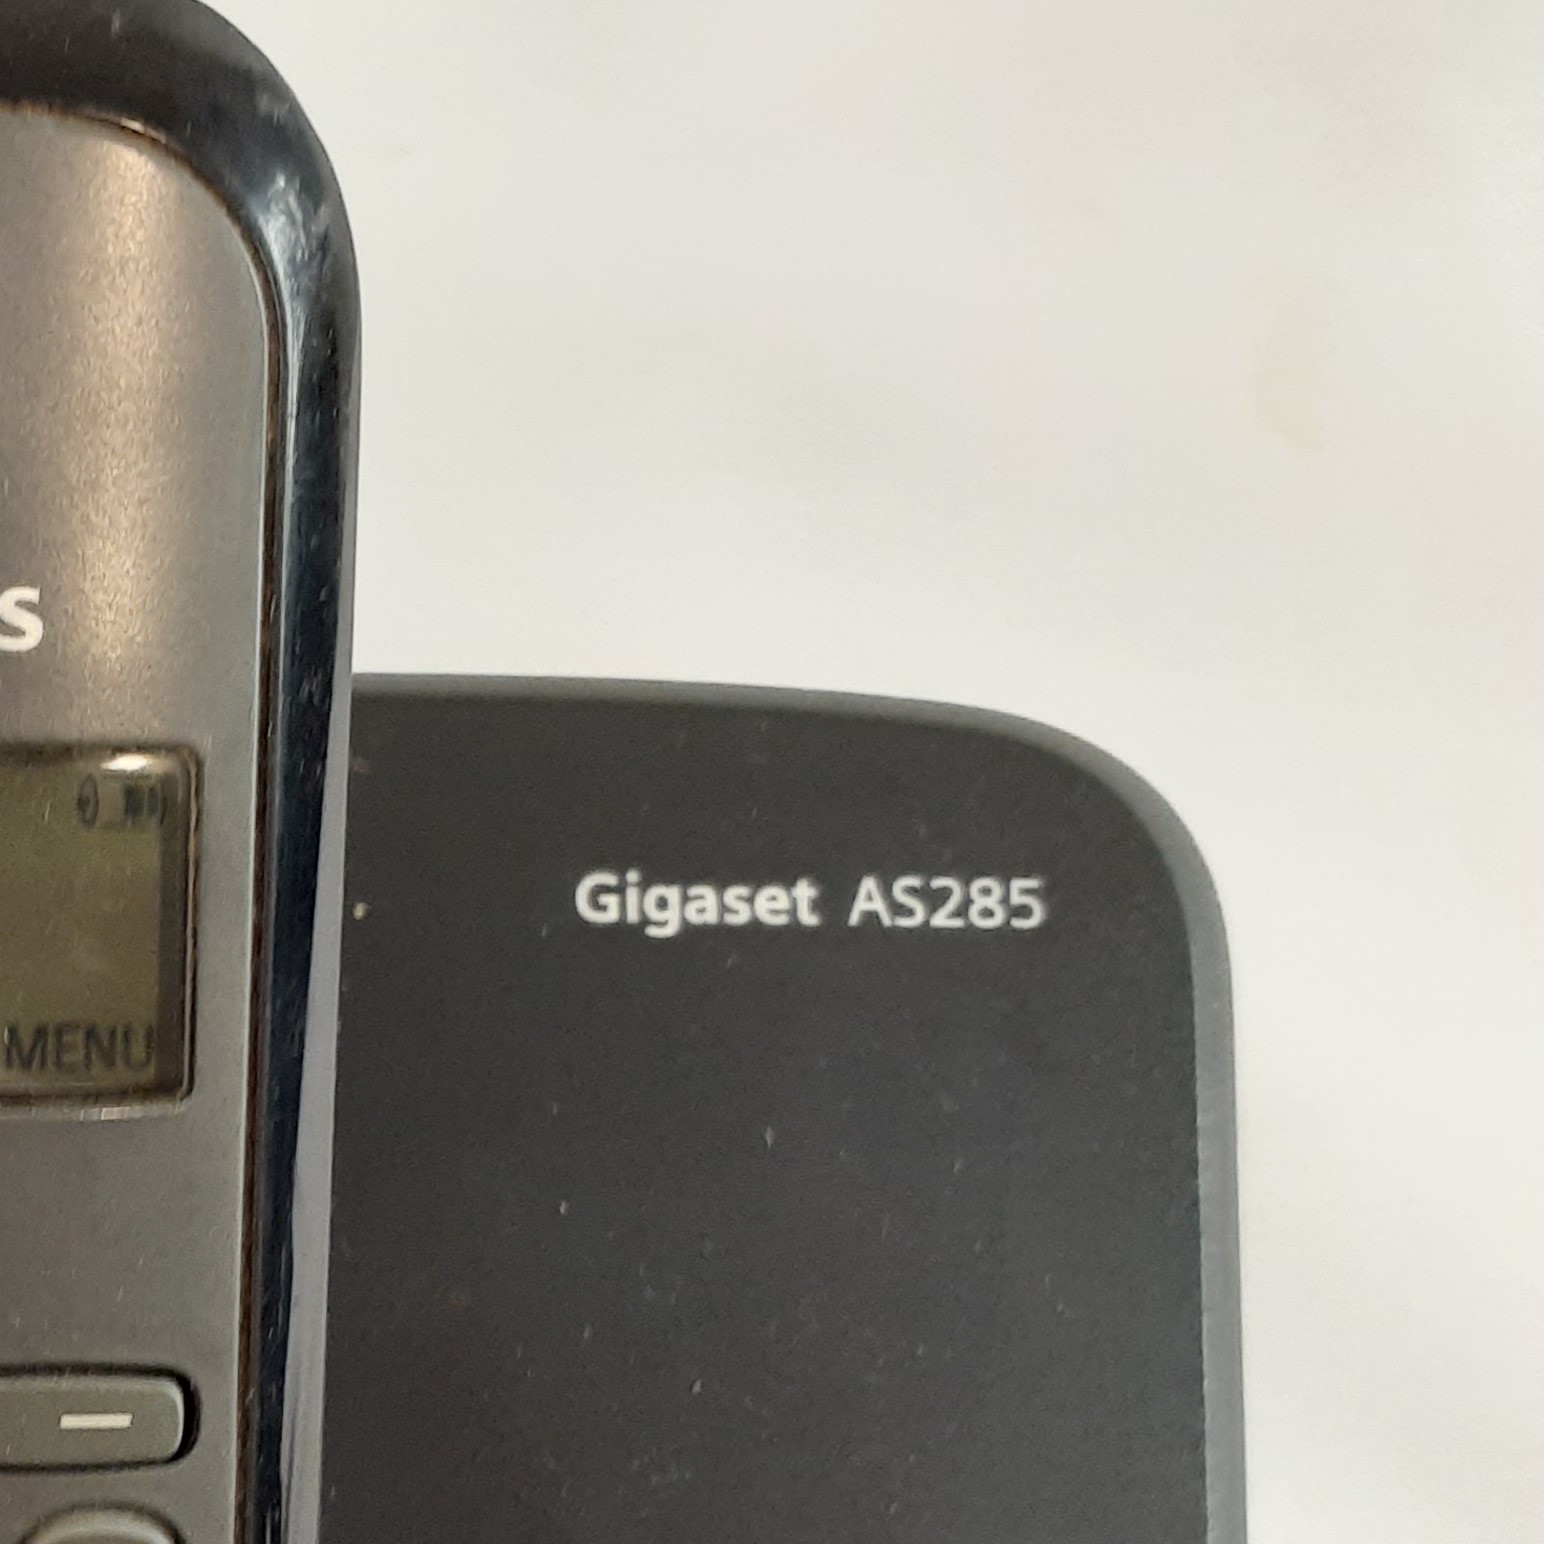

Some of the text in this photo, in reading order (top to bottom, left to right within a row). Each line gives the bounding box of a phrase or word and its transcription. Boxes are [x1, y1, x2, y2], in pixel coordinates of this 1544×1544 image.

[574, 868, 1048, 938] Gigaset AS285
[5, 1024, 155, 1073] MENU
